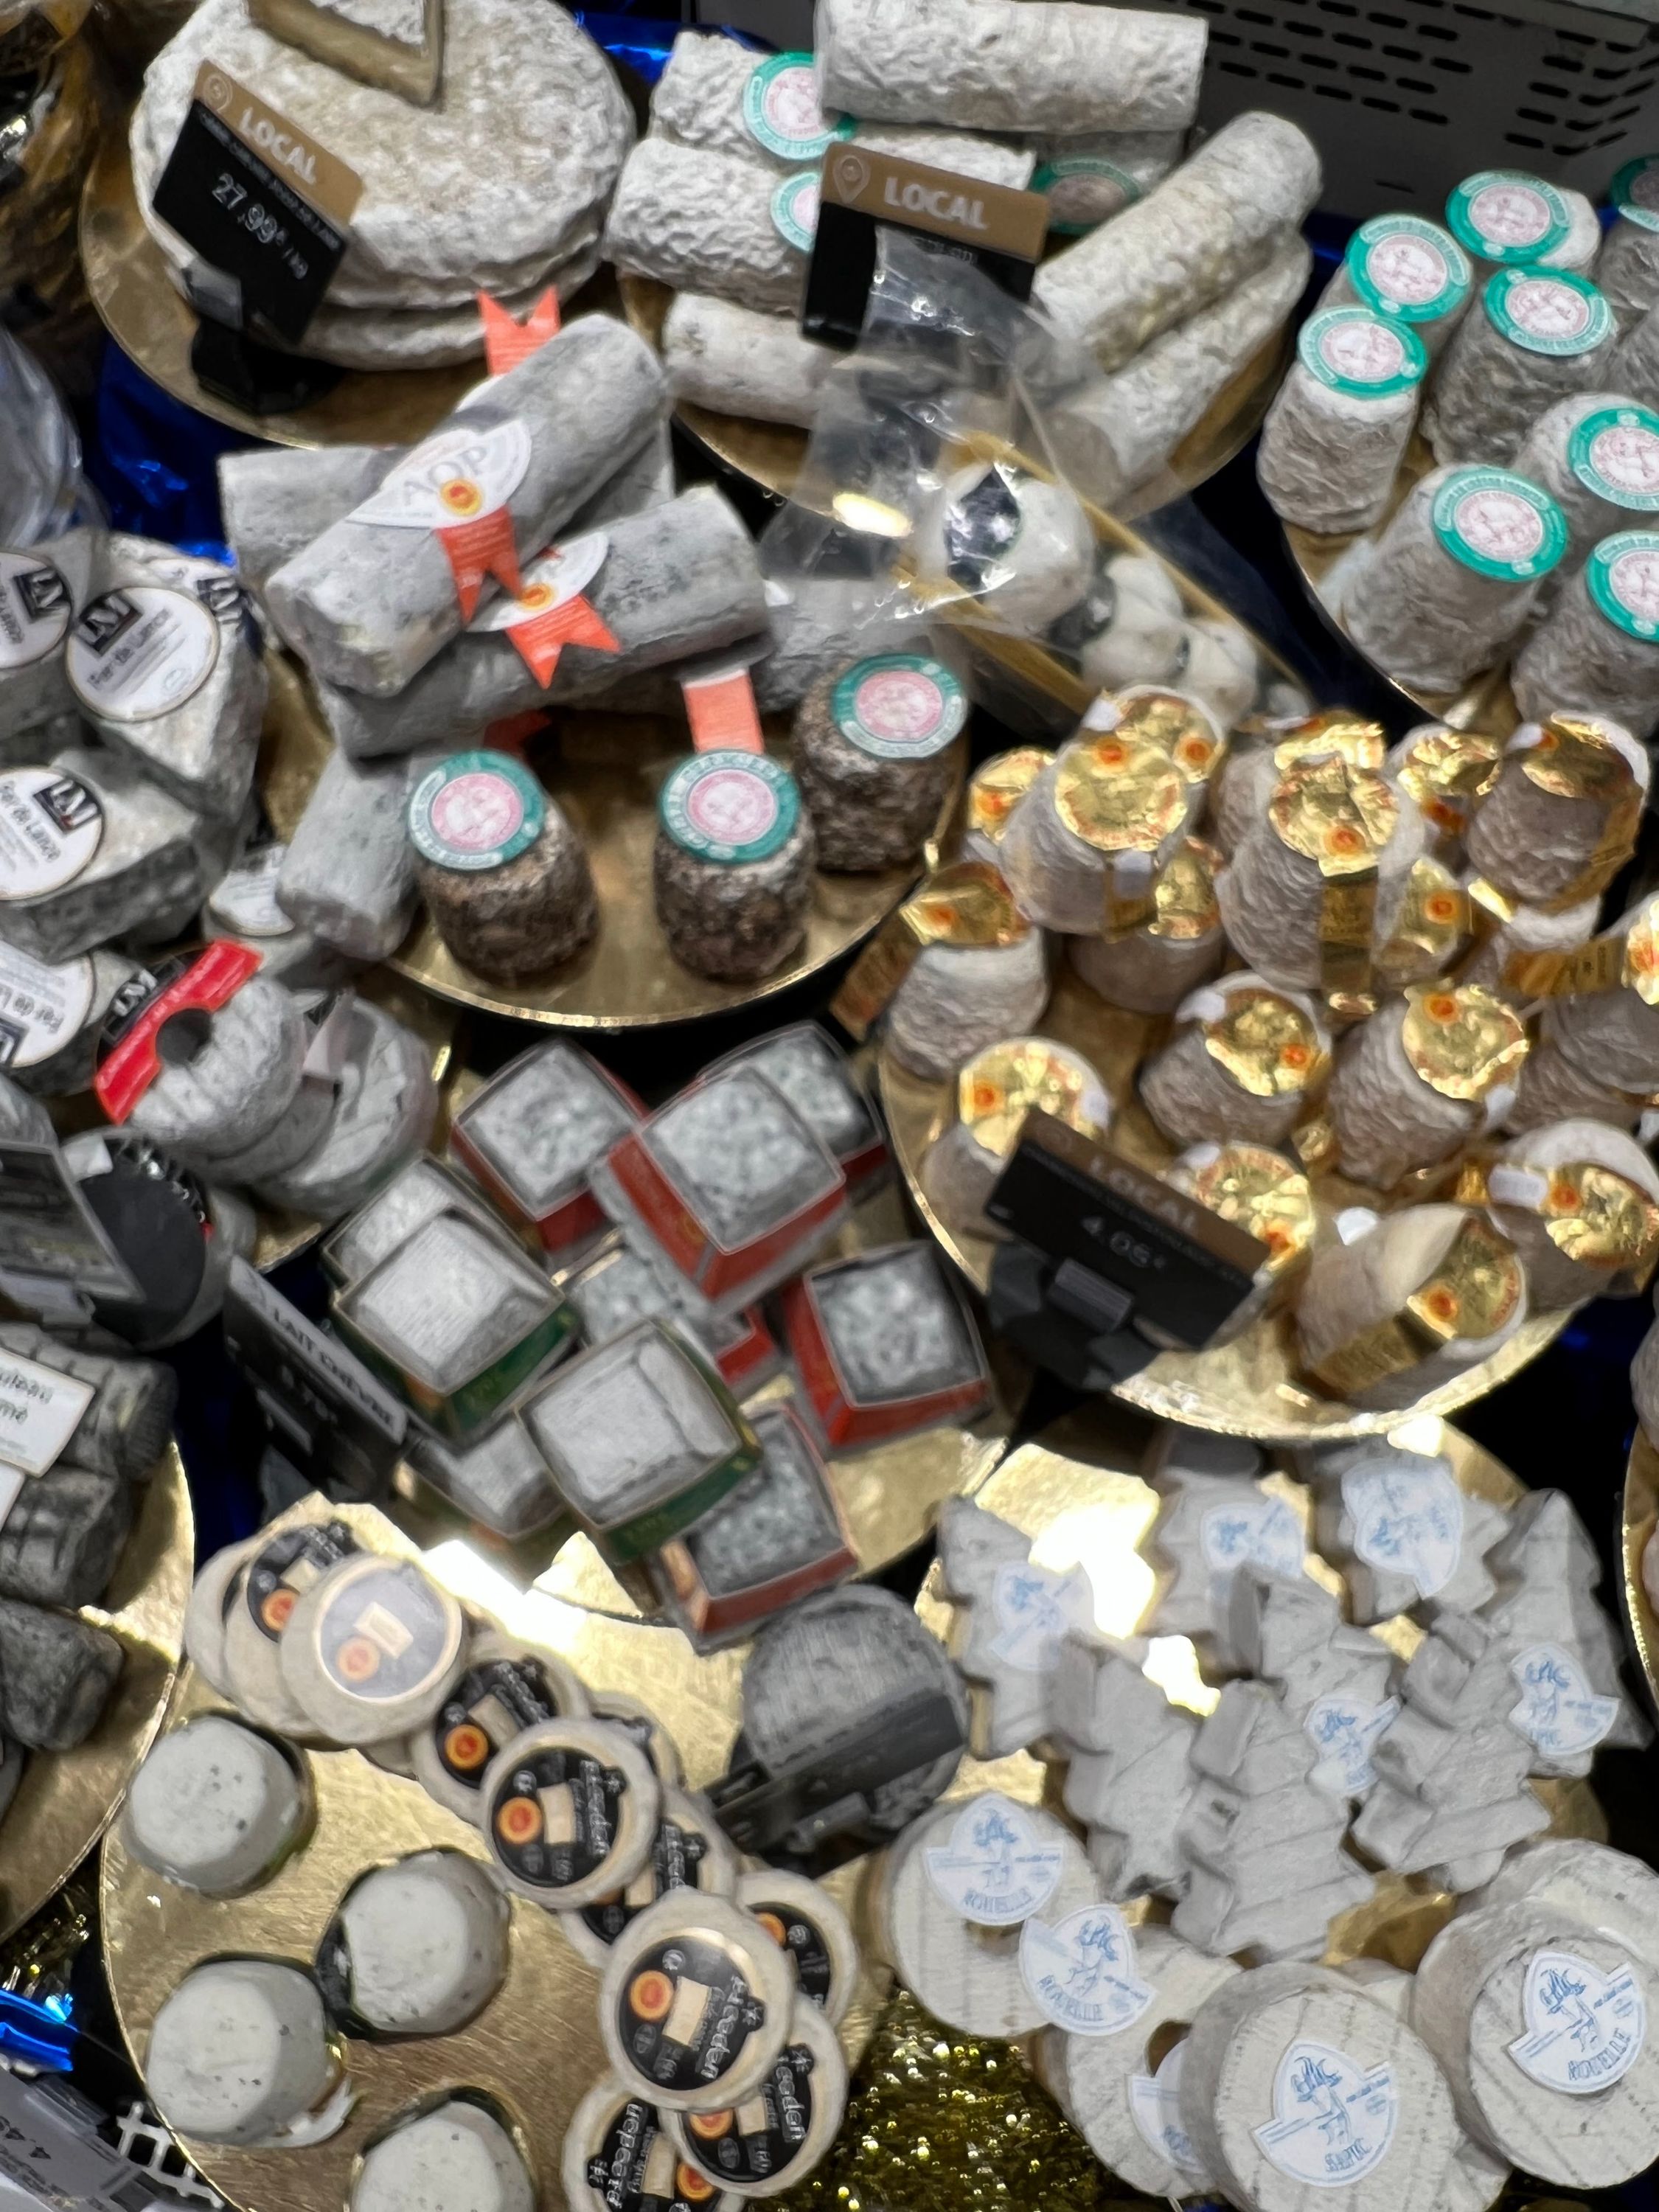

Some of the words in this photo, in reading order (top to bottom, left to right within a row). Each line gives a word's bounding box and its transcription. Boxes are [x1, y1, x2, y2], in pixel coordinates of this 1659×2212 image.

[240, 106, 319, 185] LOCAL
[885, 176, 989, 230] LOCAL
[1087, 1155, 1198, 1235] LOCAL
